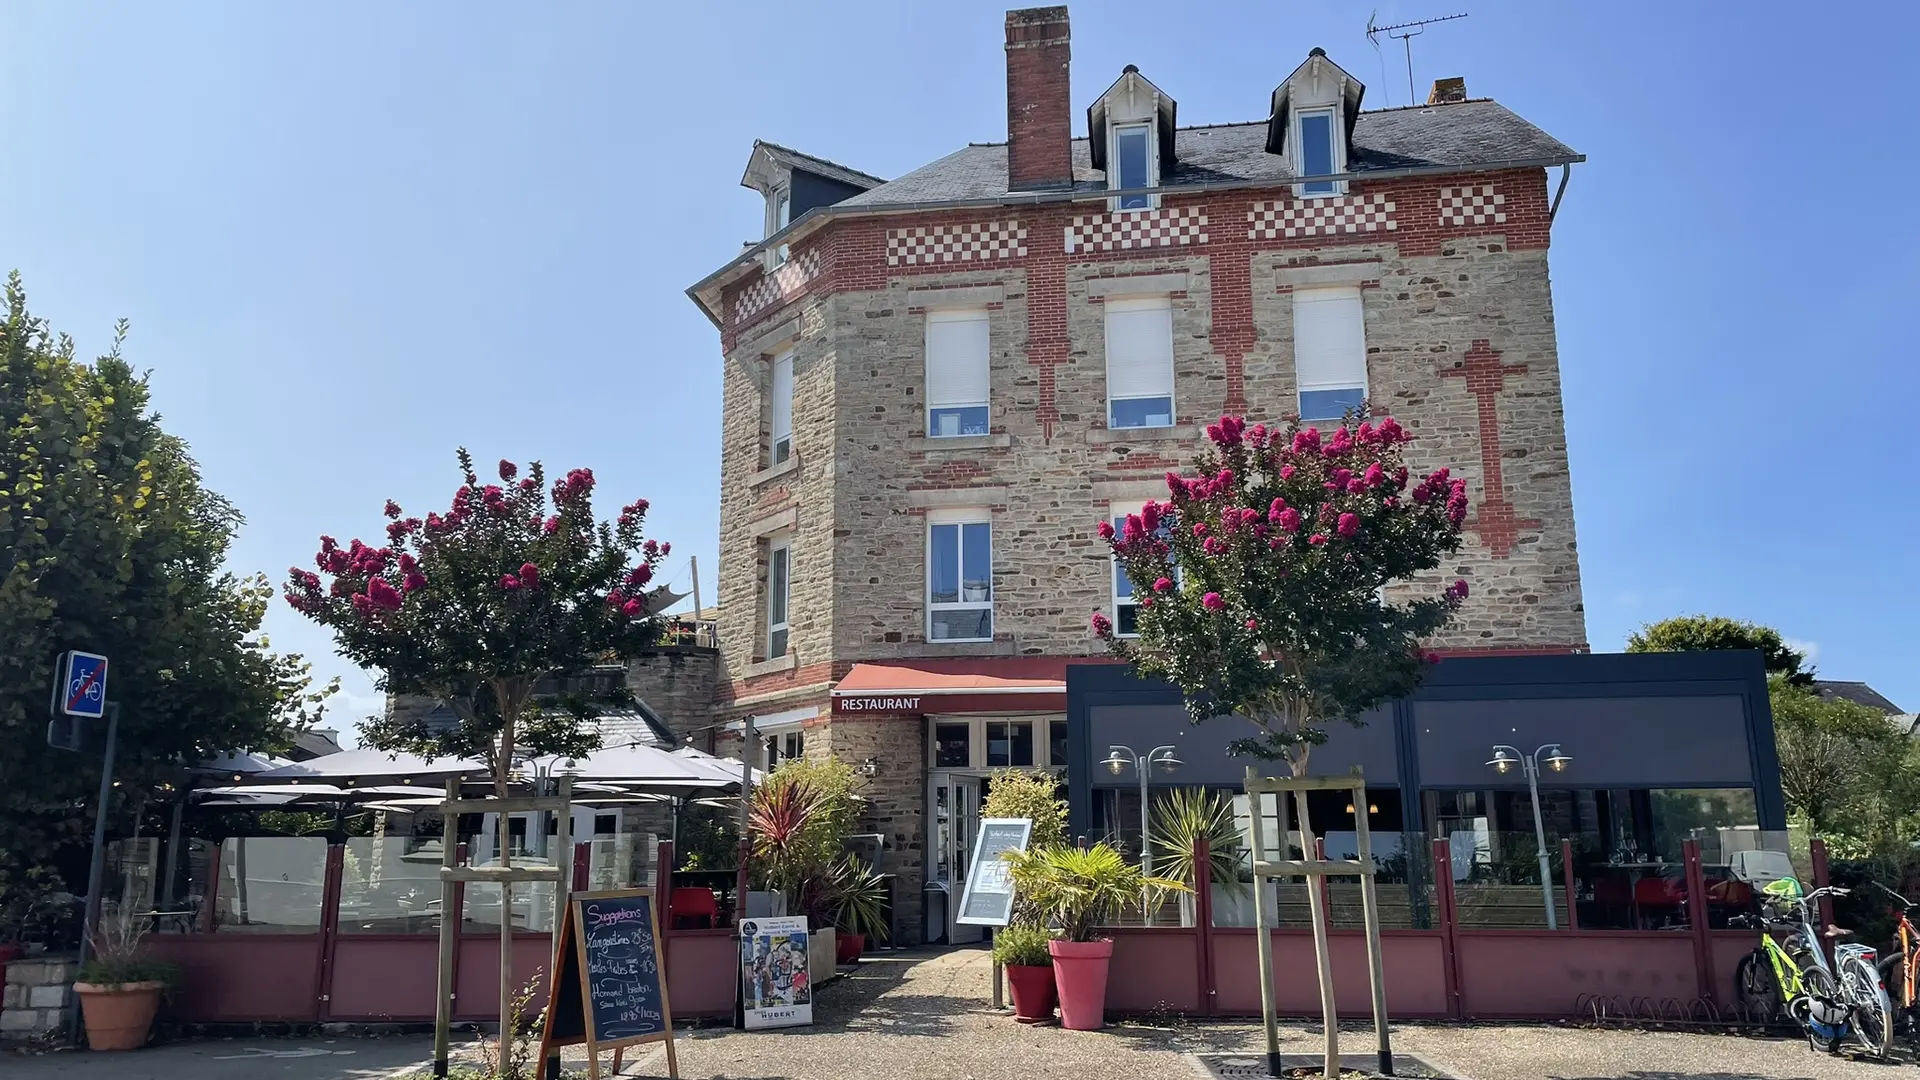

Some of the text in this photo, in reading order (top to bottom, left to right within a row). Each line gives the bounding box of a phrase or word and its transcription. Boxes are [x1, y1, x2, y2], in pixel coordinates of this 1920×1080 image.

[841, 697, 920, 710] RESTAURANT
[587, 904, 642, 925] Suggestions
[761, 1010, 796, 1019] HUBERT
